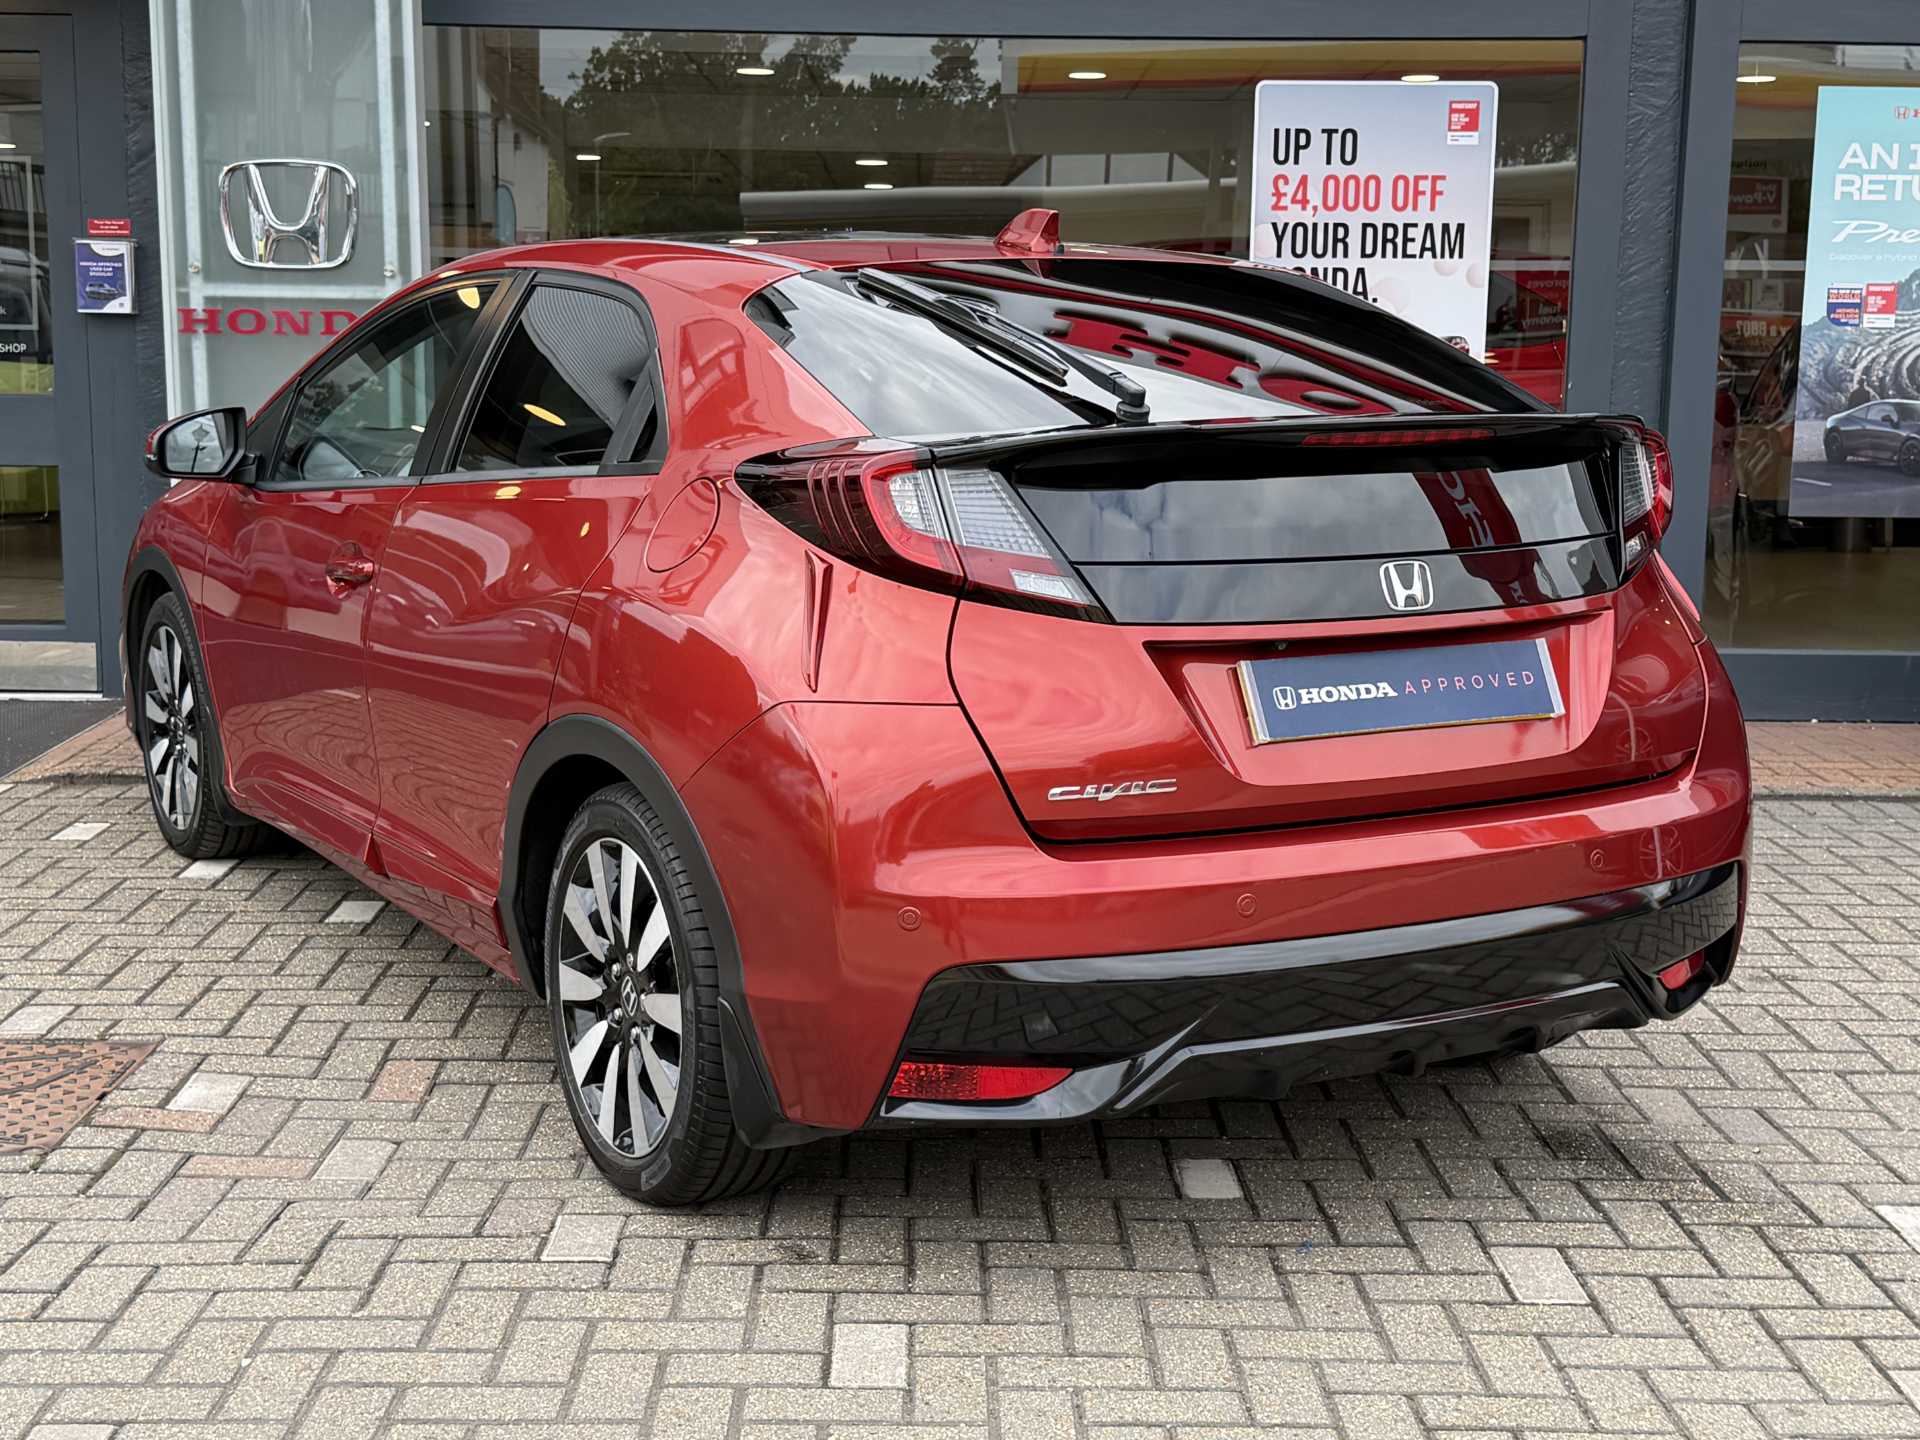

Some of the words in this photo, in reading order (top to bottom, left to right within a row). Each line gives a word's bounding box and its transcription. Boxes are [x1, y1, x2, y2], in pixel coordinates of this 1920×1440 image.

[1273, 128, 1311, 165] UP
[1321, 128, 1358, 165] TO
[1838, 142, 1900, 170] AN
[1271, 174, 1381, 217] £4,000
[1391, 174, 1447, 212] OFF
[1271, 222, 1350, 259] YOUR
[1360, 222, 1465, 259] DREAM
[177, 307, 360, 336] HOND
[0, 343, 27, 353] SHOP
[1298, 682, 1398, 705] HONDA
[1404, 671, 1535, 695] APPROVED
[1048, 778, 1177, 801] CIVIC
